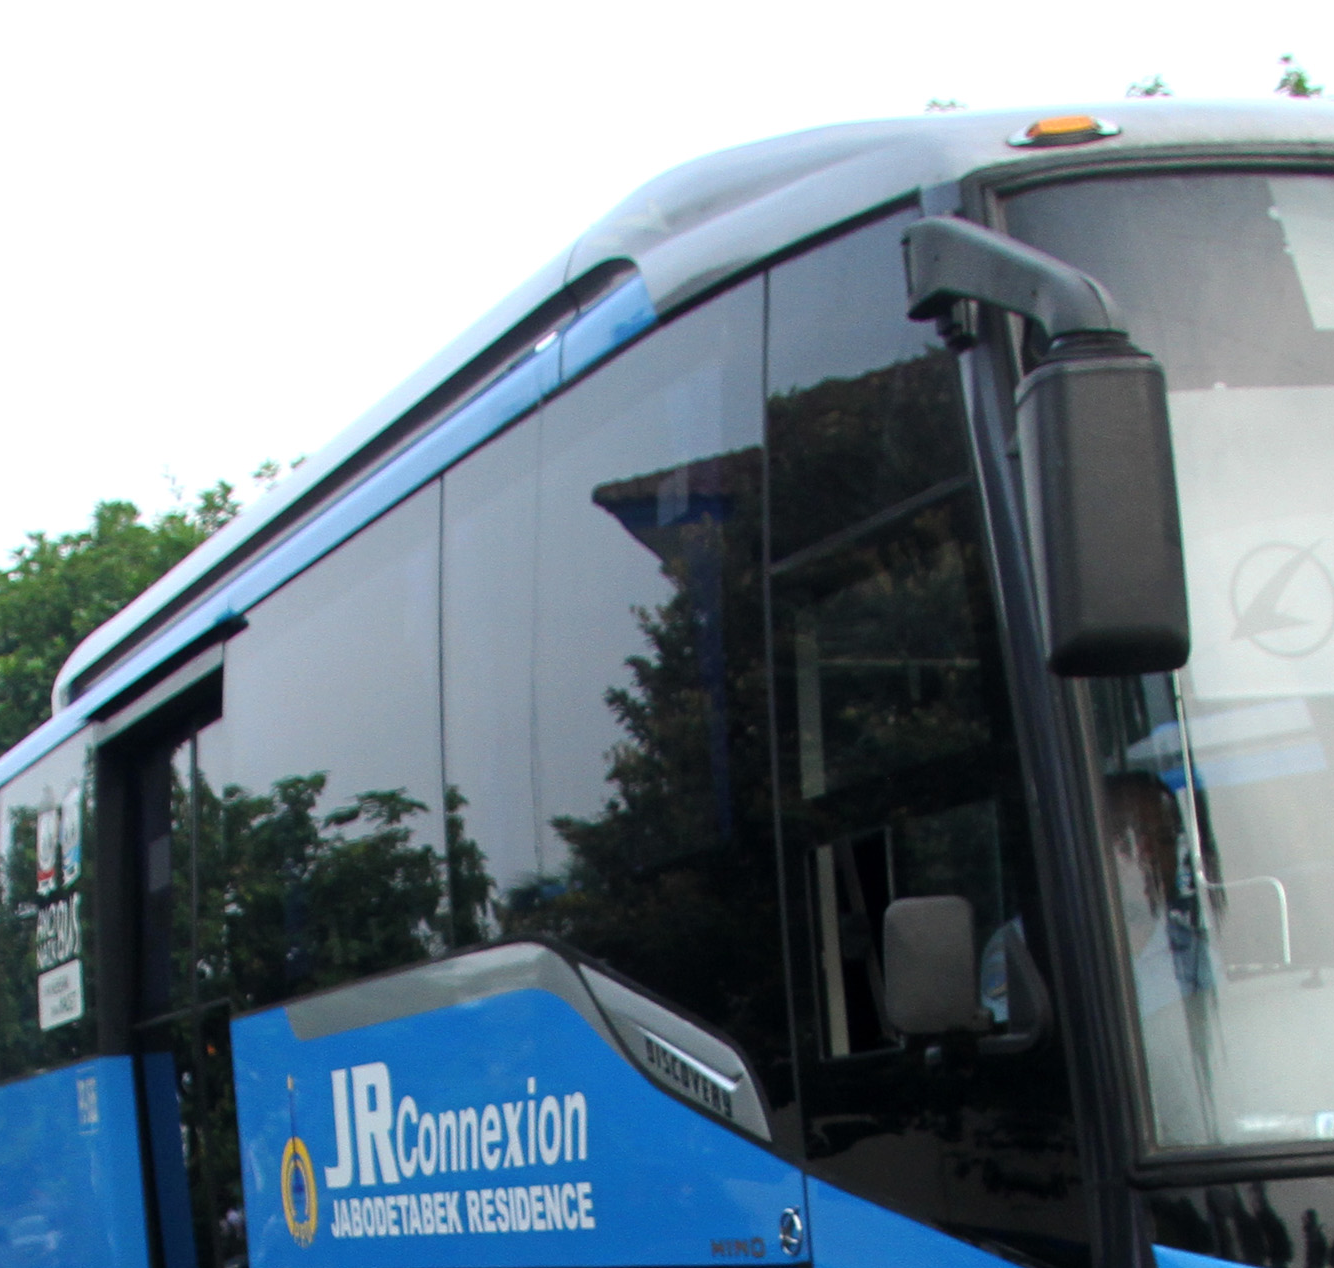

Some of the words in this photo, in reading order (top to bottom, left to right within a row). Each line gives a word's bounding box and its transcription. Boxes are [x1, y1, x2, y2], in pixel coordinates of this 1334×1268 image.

[646, 1036, 734, 1117] DISCOVERY
[330, 1190, 463, 1237] JABODETABEK
[468, 1182, 595, 1233] RESIDENCE
[711, 1237, 766, 1259] HINO
